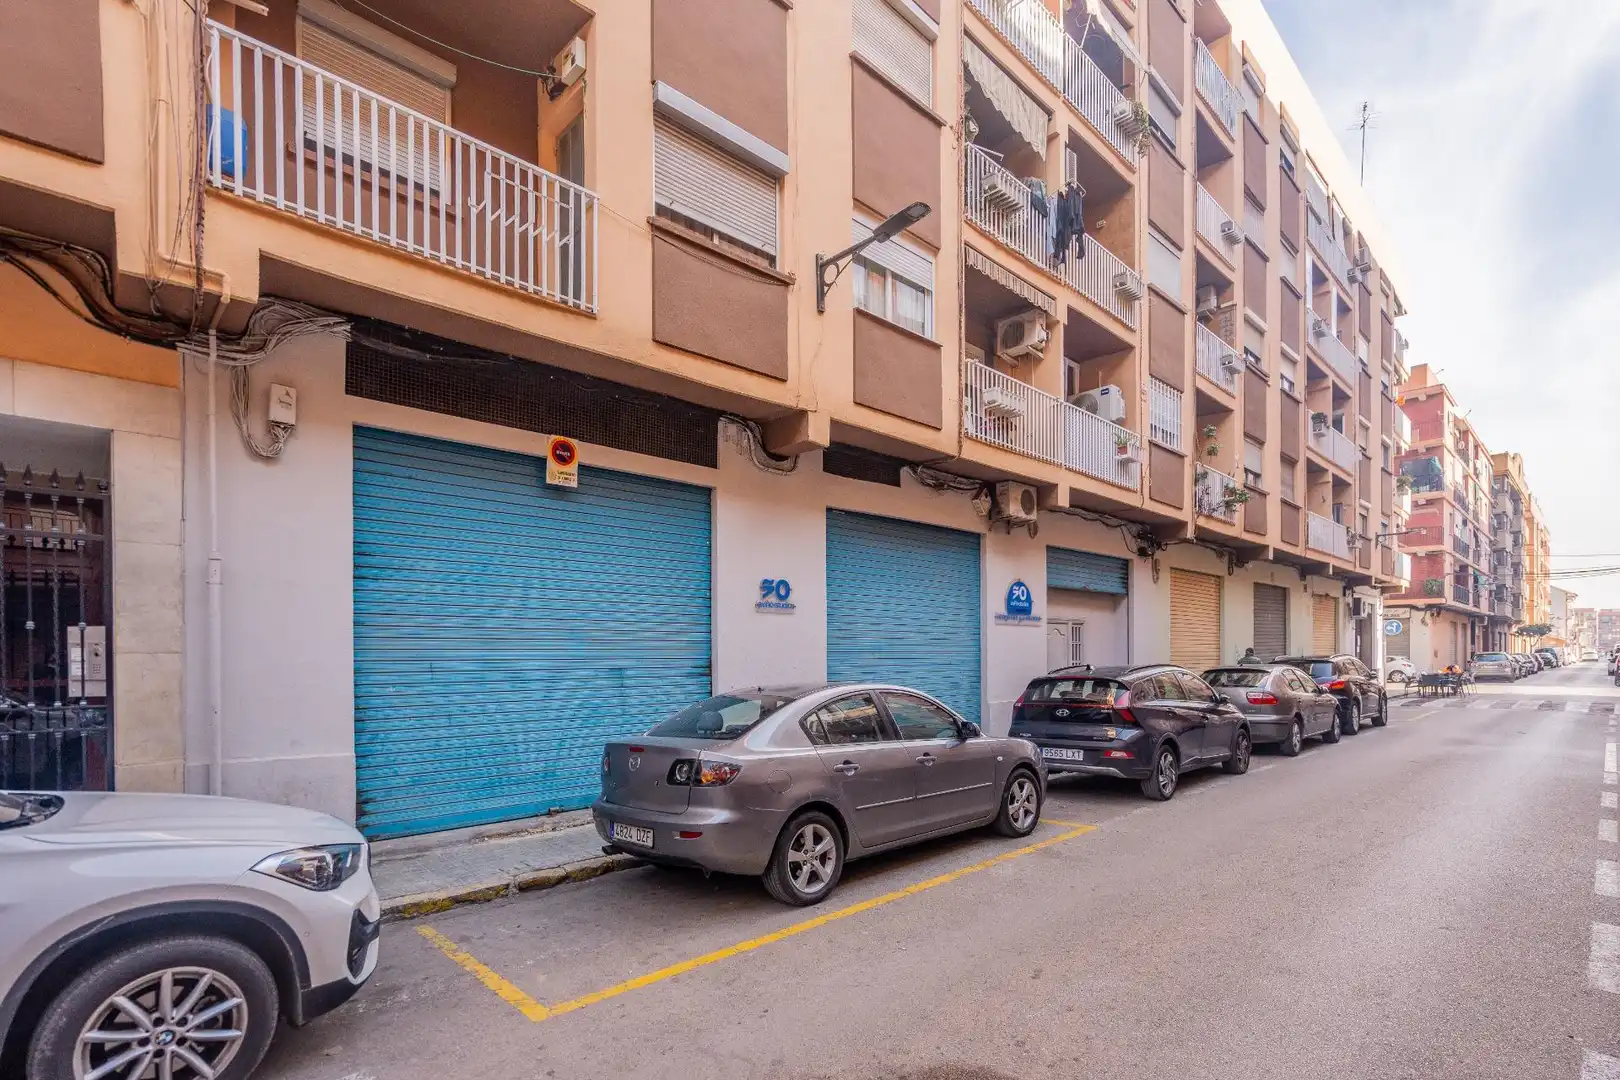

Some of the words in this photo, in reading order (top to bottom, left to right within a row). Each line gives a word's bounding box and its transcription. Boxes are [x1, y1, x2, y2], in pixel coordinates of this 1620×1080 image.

[1044, 749, 1063, 757] 9565
[1066, 750, 1081, 759] LXT
[616, 825, 633, 839] 4824
[637, 829, 651, 843] DZF
